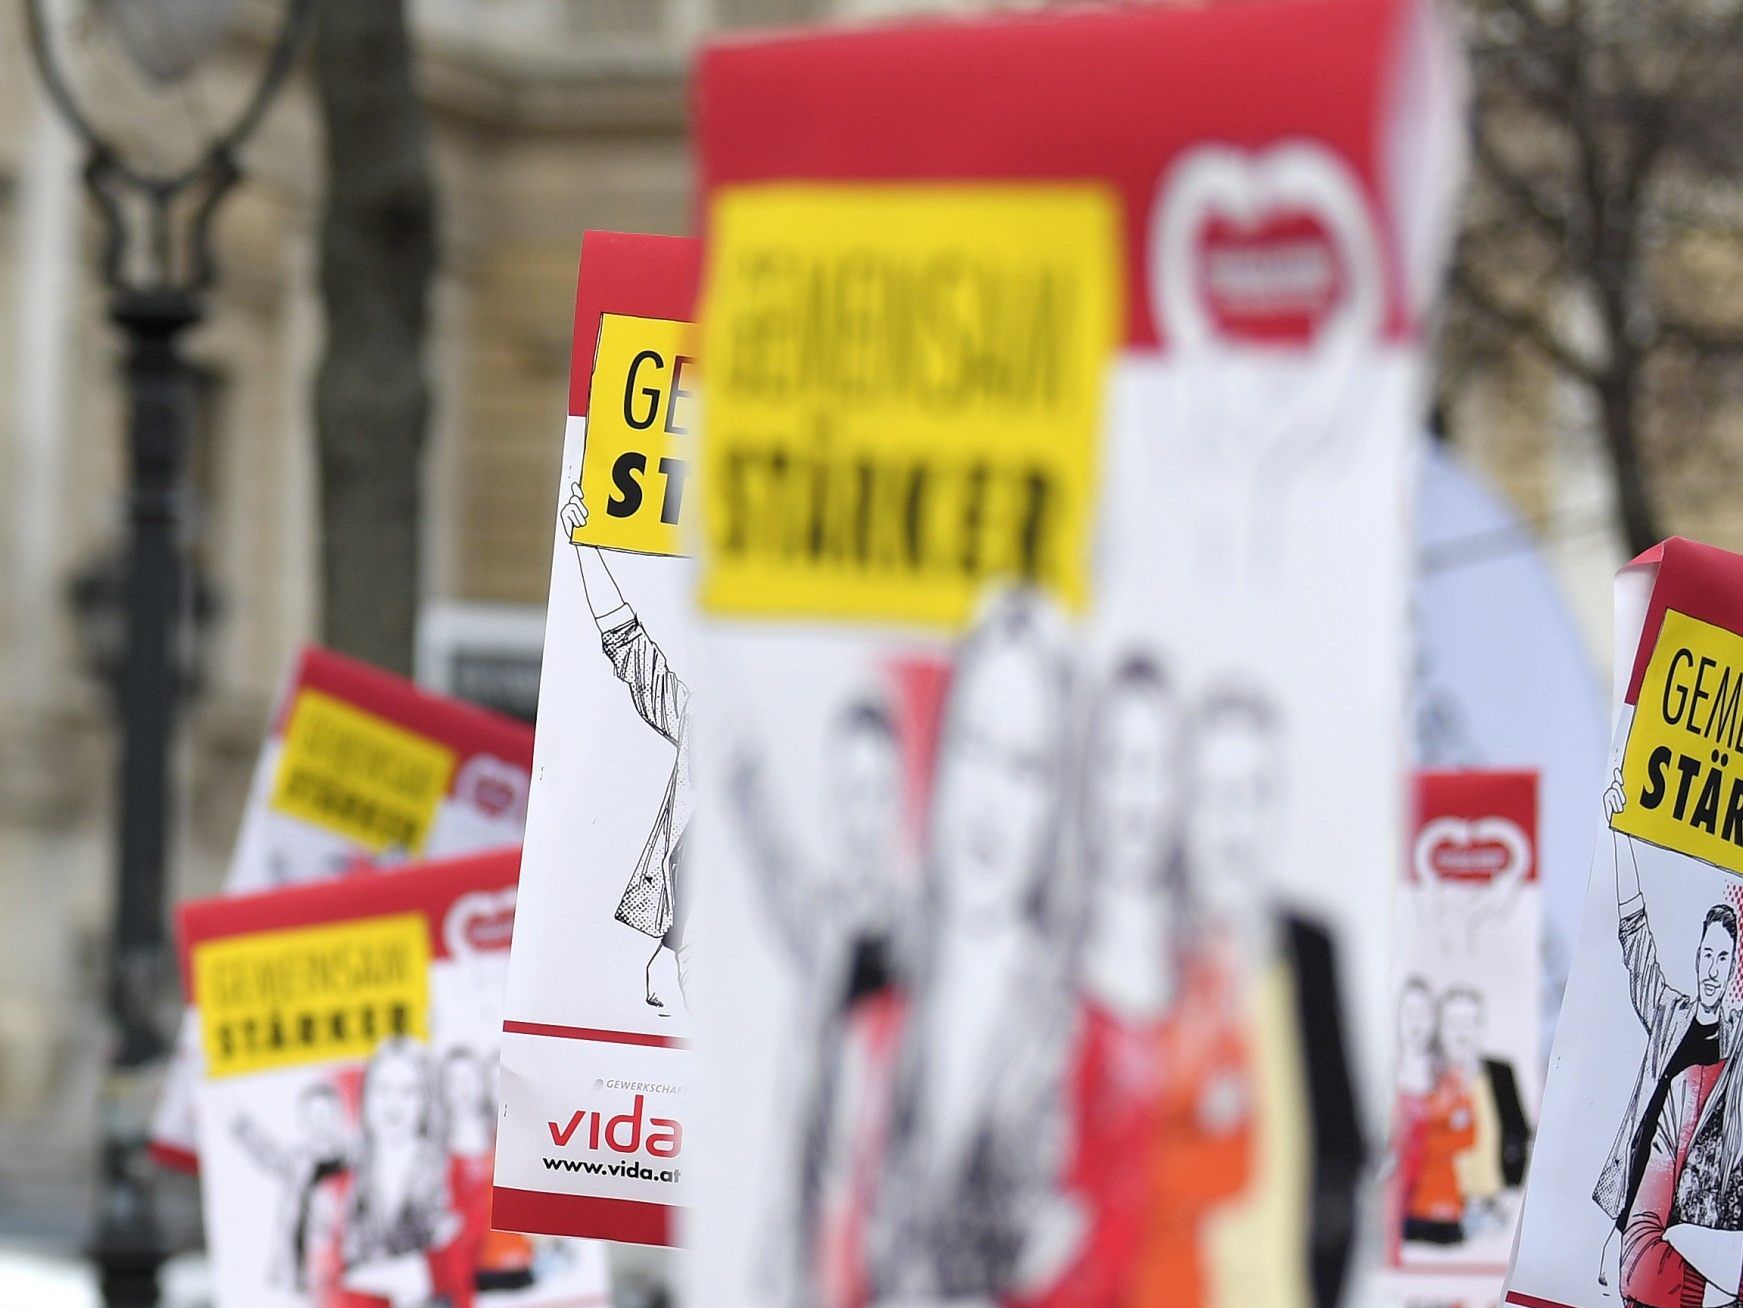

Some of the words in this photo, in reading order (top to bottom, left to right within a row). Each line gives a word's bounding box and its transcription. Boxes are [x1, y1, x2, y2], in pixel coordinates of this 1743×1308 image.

[1662, 648, 1743, 753] GEM
[606, 1078, 687, 1096] GEWERKSCHAF
[548, 1094, 684, 1158] vida
[542, 1157, 682, 1184] www.vida.at
